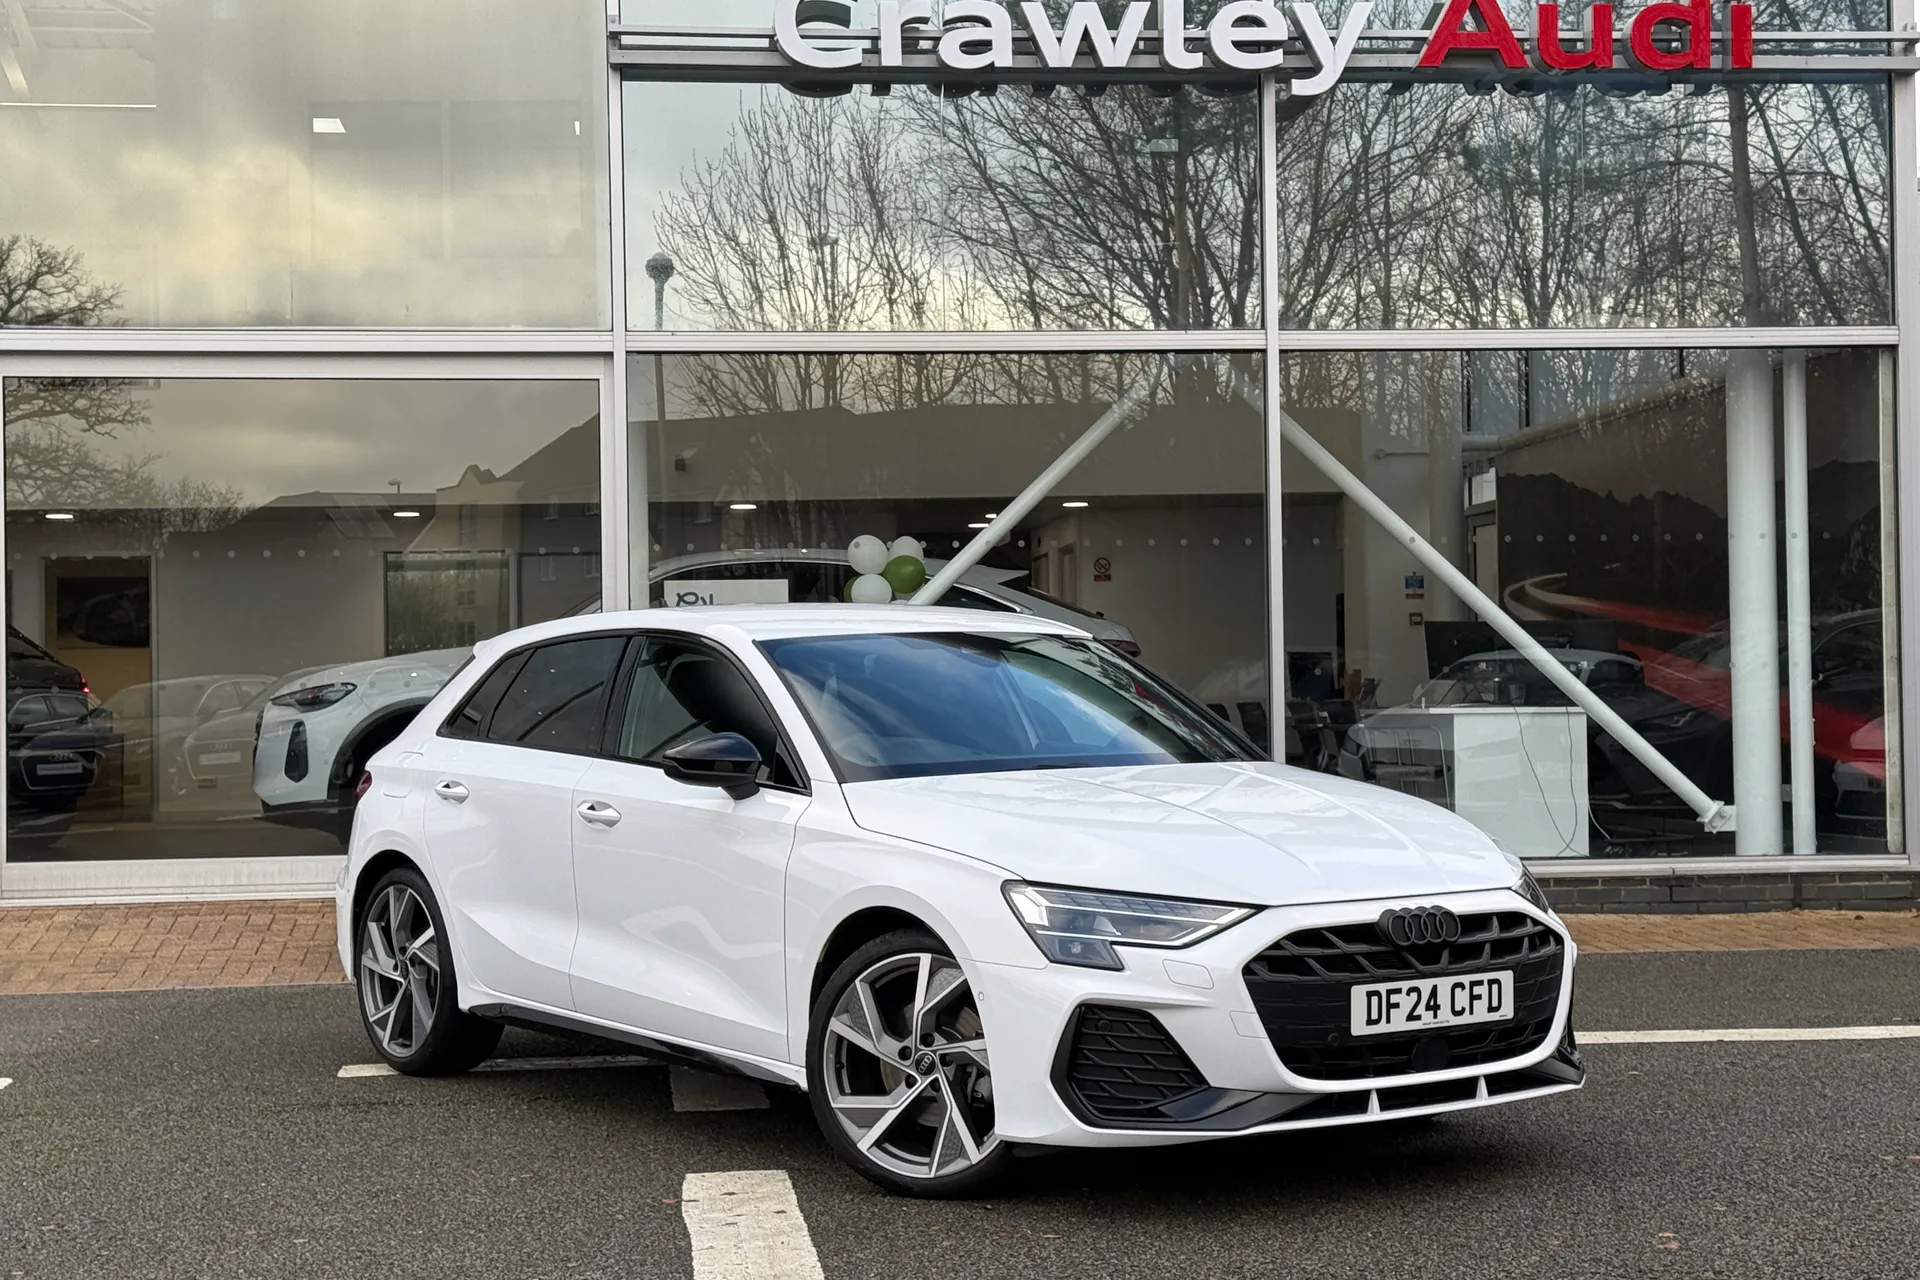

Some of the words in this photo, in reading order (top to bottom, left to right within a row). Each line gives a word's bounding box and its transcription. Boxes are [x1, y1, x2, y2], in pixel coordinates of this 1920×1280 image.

[774, 0, 1373, 96] Crawley
[1417, 0, 1753, 70] Audi
[1365, 984, 1441, 1026] DF24
[1450, 978, 1503, 1017] CFD
